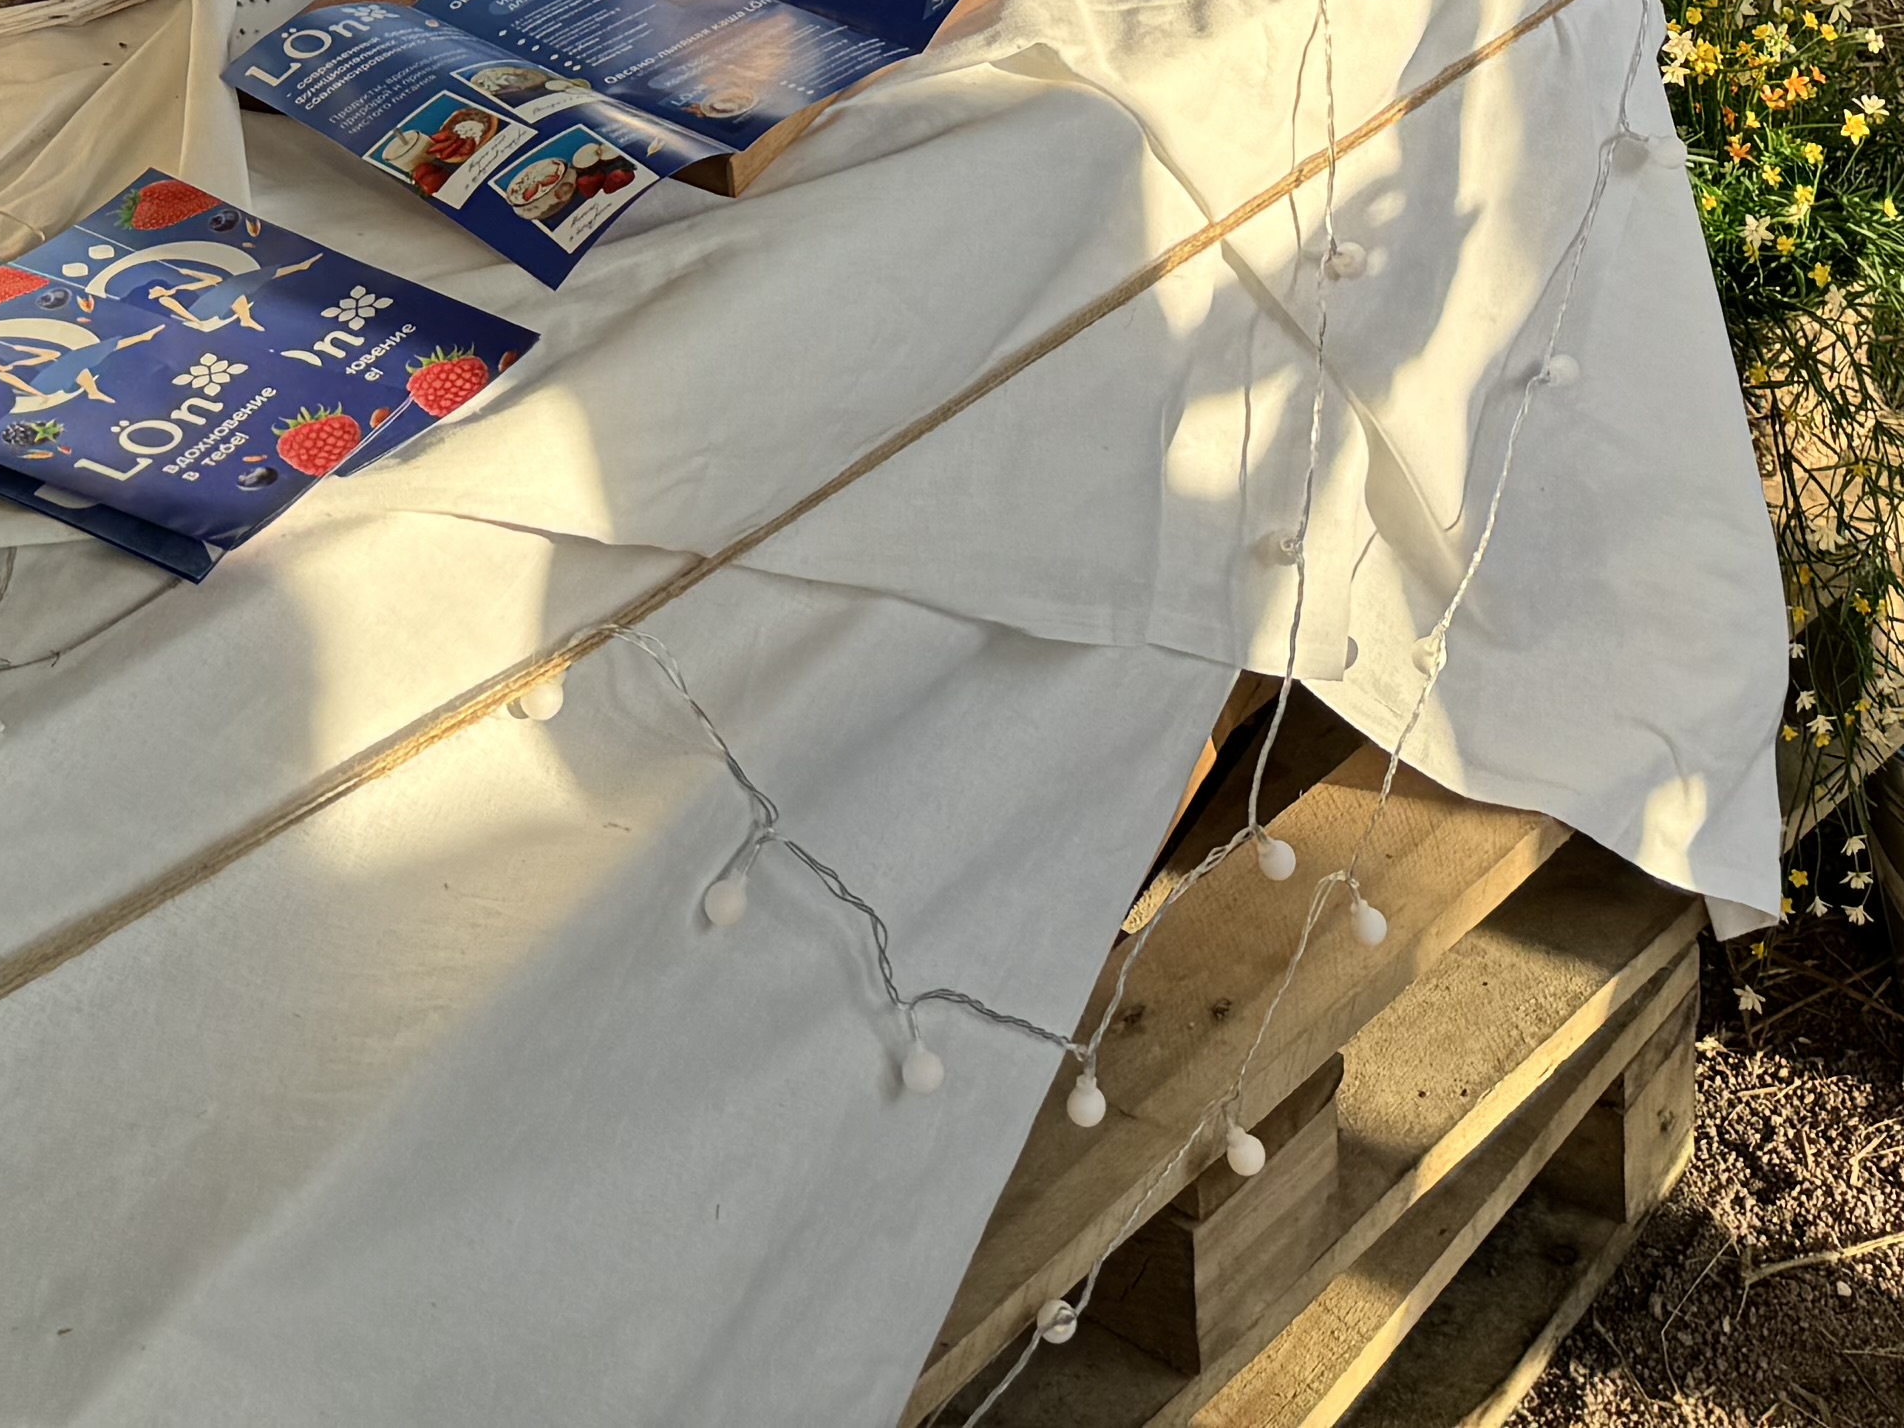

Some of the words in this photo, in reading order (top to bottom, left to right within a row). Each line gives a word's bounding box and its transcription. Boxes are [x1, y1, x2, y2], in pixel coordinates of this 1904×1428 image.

[245, 16, 371, 87] LÖn
[74, 396, 223, 481] LÖn
[162, 386, 277, 475] вдохновение
[182, 470, 200, 482] в
[201, 431, 249, 467] тебе!
